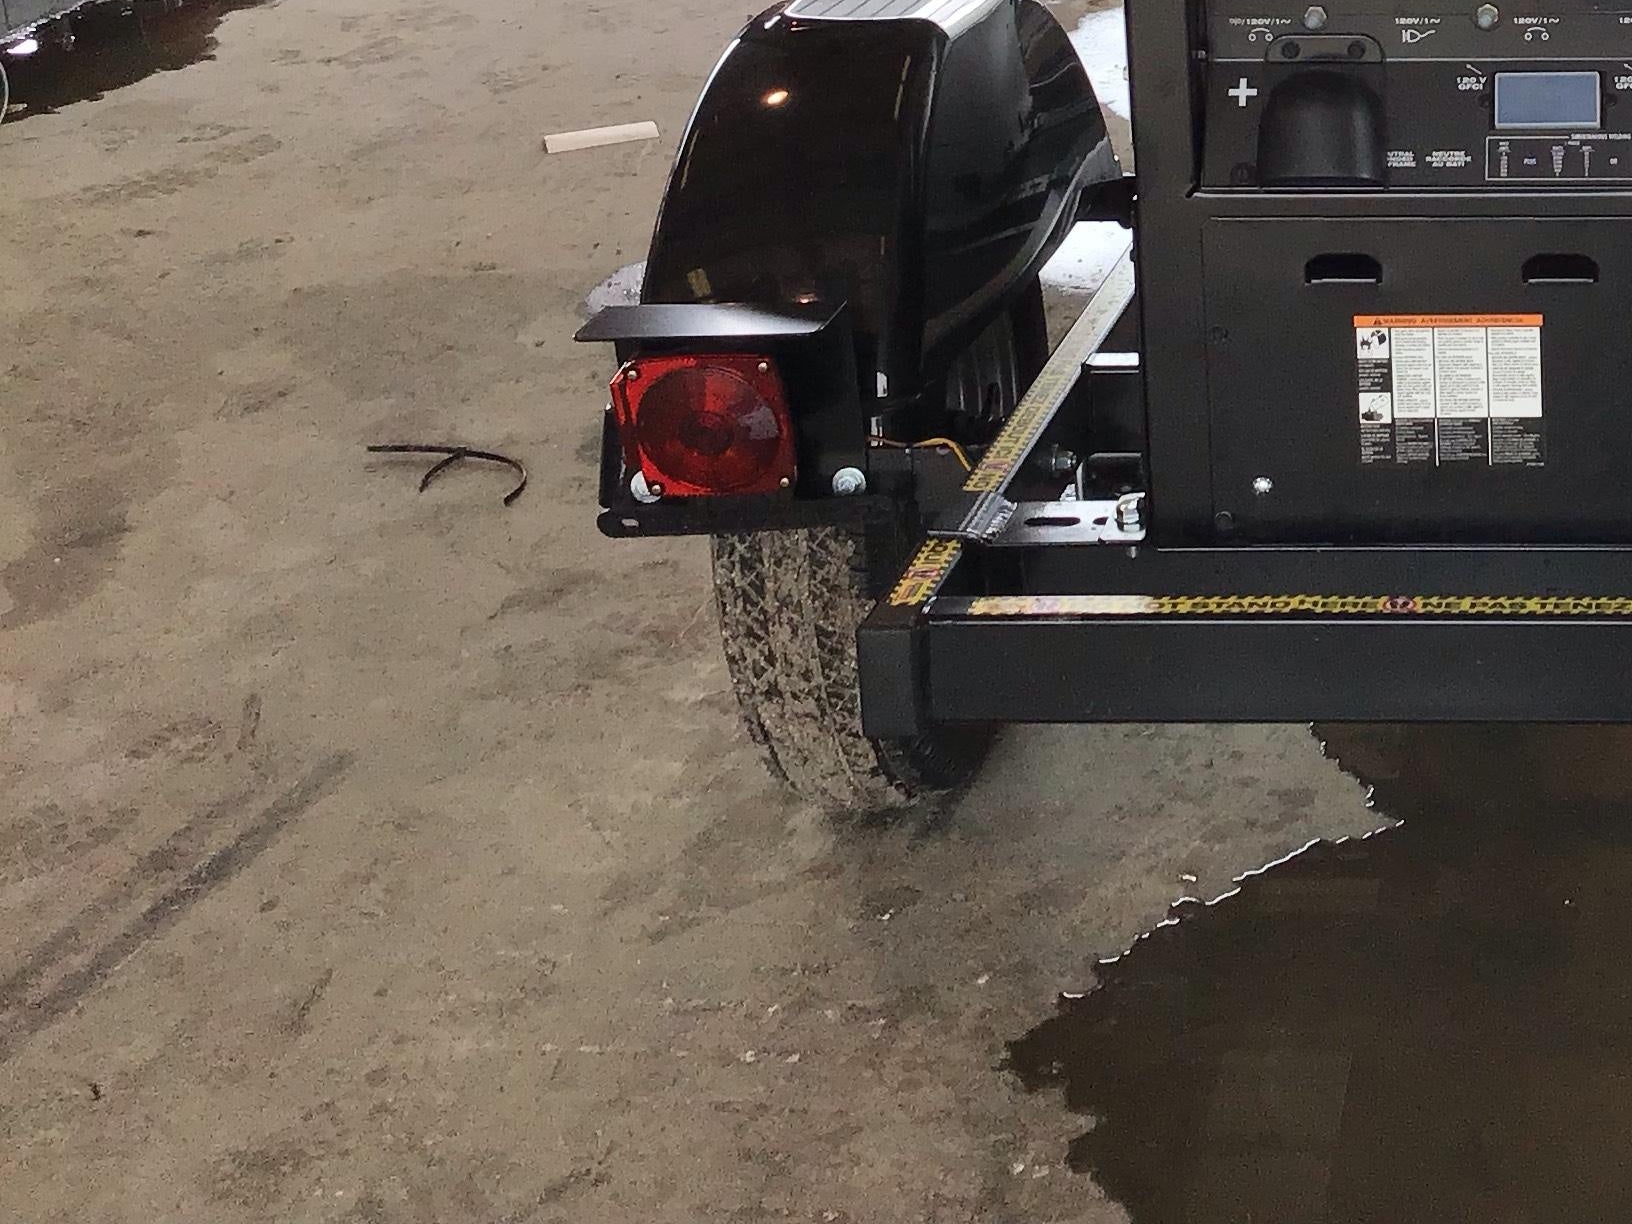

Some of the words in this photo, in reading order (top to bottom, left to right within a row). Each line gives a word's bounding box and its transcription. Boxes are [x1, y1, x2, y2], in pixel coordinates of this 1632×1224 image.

[1190, 601, 1292, 609] STAND
[1297, 599, 1380, 609] HERE
[1468, 601, 1527, 610] PAS
